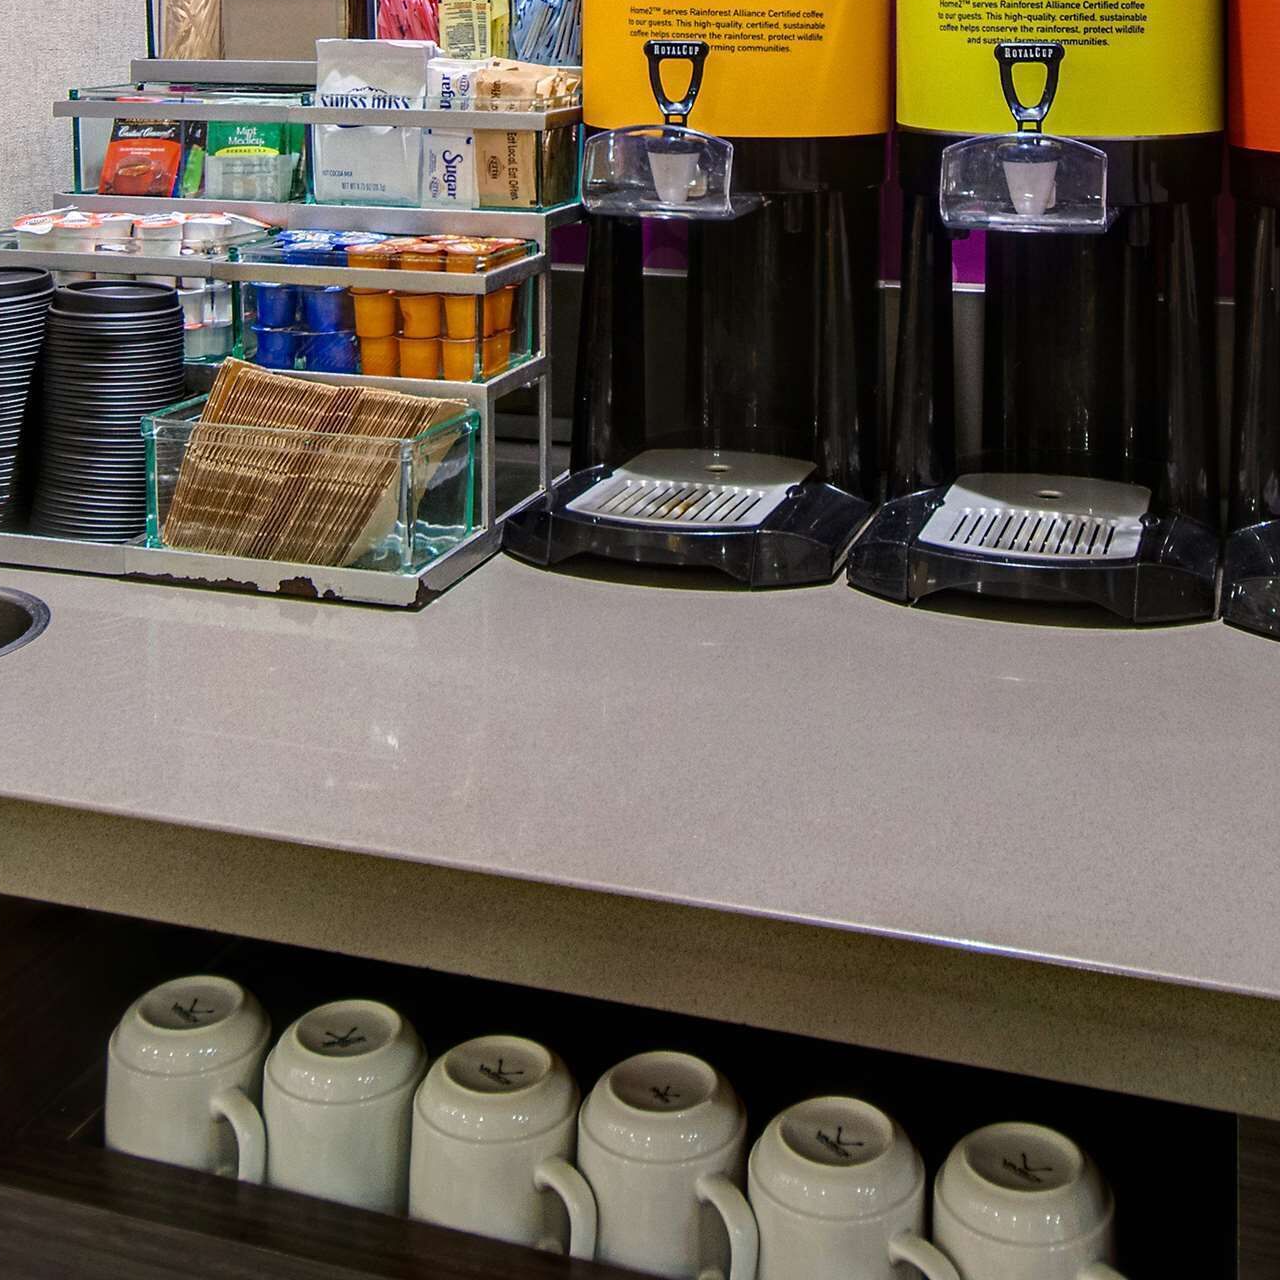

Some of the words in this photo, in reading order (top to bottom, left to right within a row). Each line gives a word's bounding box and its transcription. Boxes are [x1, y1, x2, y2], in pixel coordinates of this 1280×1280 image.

[1000, 0, 1043, 9] Rainforest
[1045, 0, 1080, 9] Alliance
[1082, 1, 1119, 10] Certified
[1121, 1, 1145, 10] coffee
[663, 8, 687, 16] serves
[690, 8, 731, 17] Rainforest
[733, 9, 766, 18] Alliance
[768, 9, 800, 18] Certified
[802, 10, 824, 18] coffee
[986, 12, 1002, 20] This
[1100, 13, 1147, 22] sustainable
[676, 19, 692, 27] This
[783, 21, 825, 30] sustainable
[939, 24, 958, 32] coffee
[960, 24, 980, 33] helps
[1020, 25, 1034, 33] the
[1083, 26, 1113, 35] protect
[1115, 26, 1145, 34] wildlife
[650, 31, 669, 40] helps
[768, 33, 795, 42] protect
[797, 33, 824, 41] wildlife
[711, 45, 735, 53] rming
[439, 74, 455, 110] ugar
[236, 126, 257, 136] Mint
[507, 132, 517, 144] Eat
[442, 150, 463, 200] Sugar
[508, 167, 518, 179] Eat
